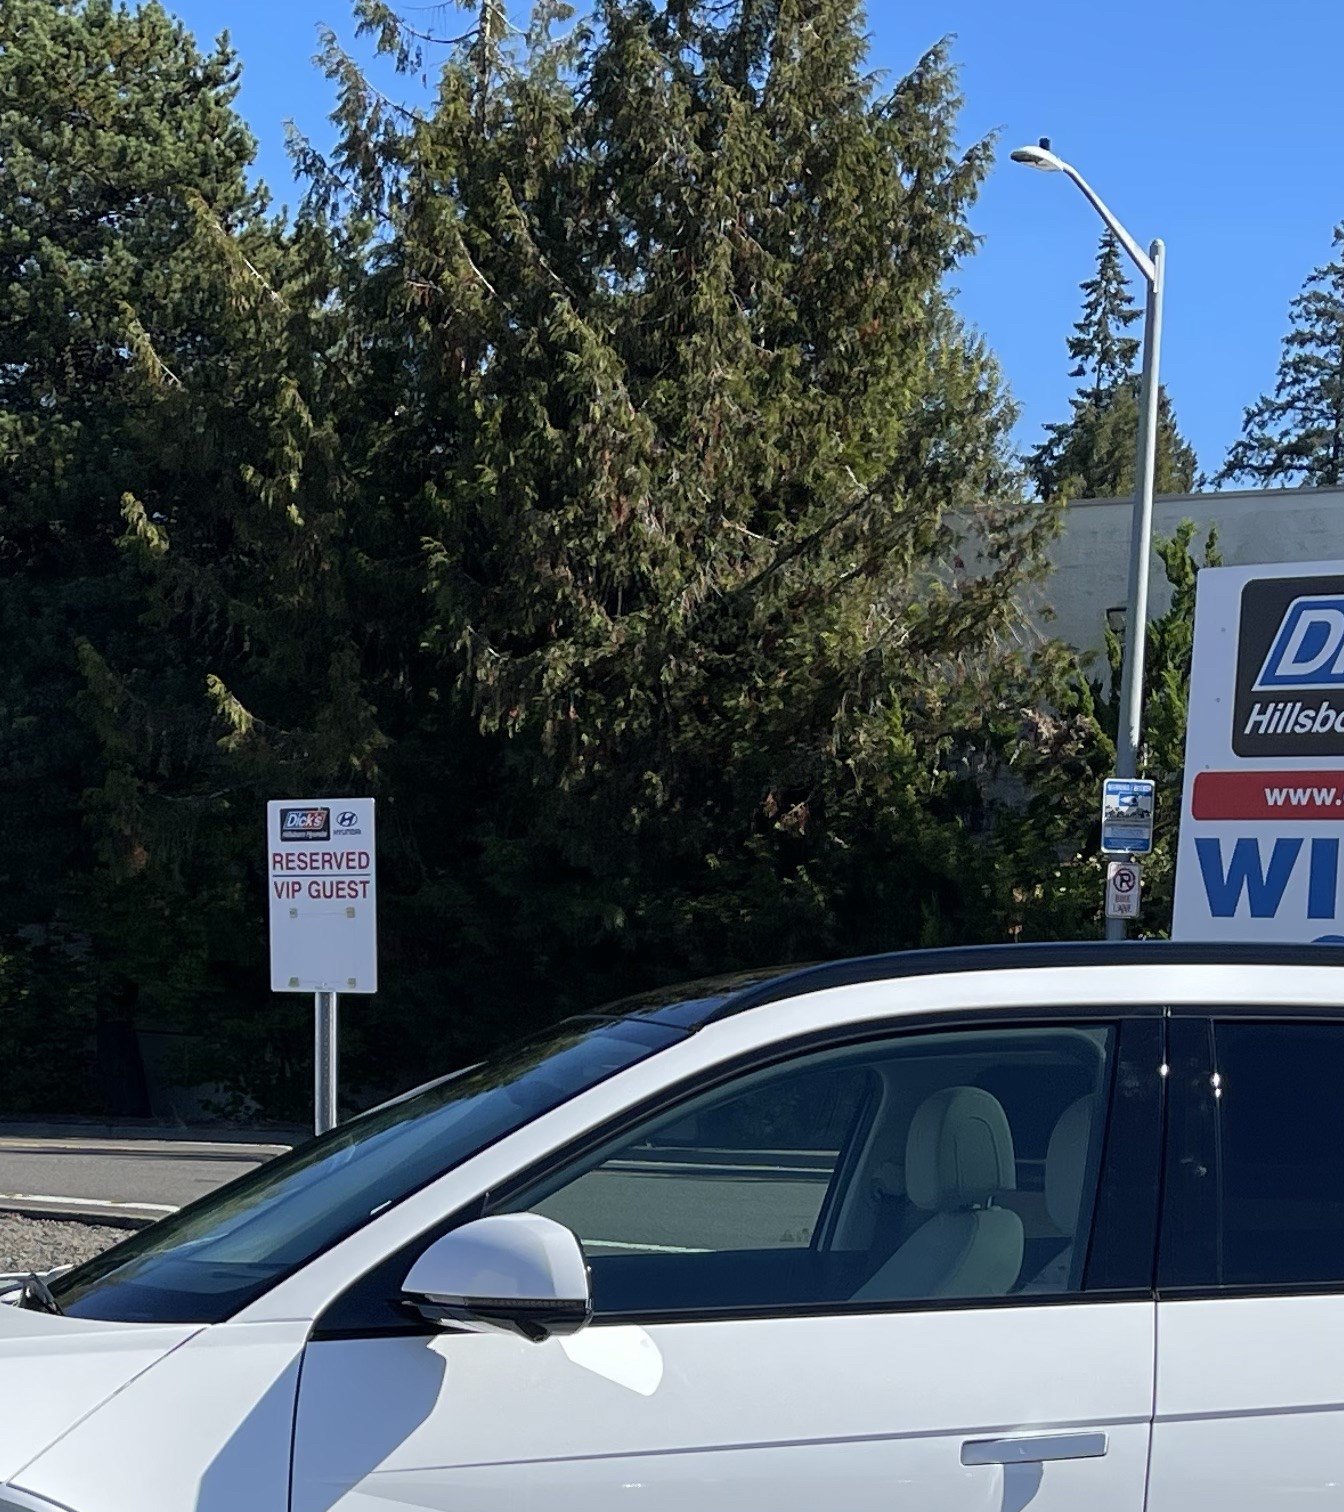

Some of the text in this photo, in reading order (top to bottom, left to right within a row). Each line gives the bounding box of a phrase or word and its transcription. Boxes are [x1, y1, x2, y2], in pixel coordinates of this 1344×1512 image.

[272, 851, 370, 871] RESERVED
[274, 880, 370, 899] VIP GUEST
